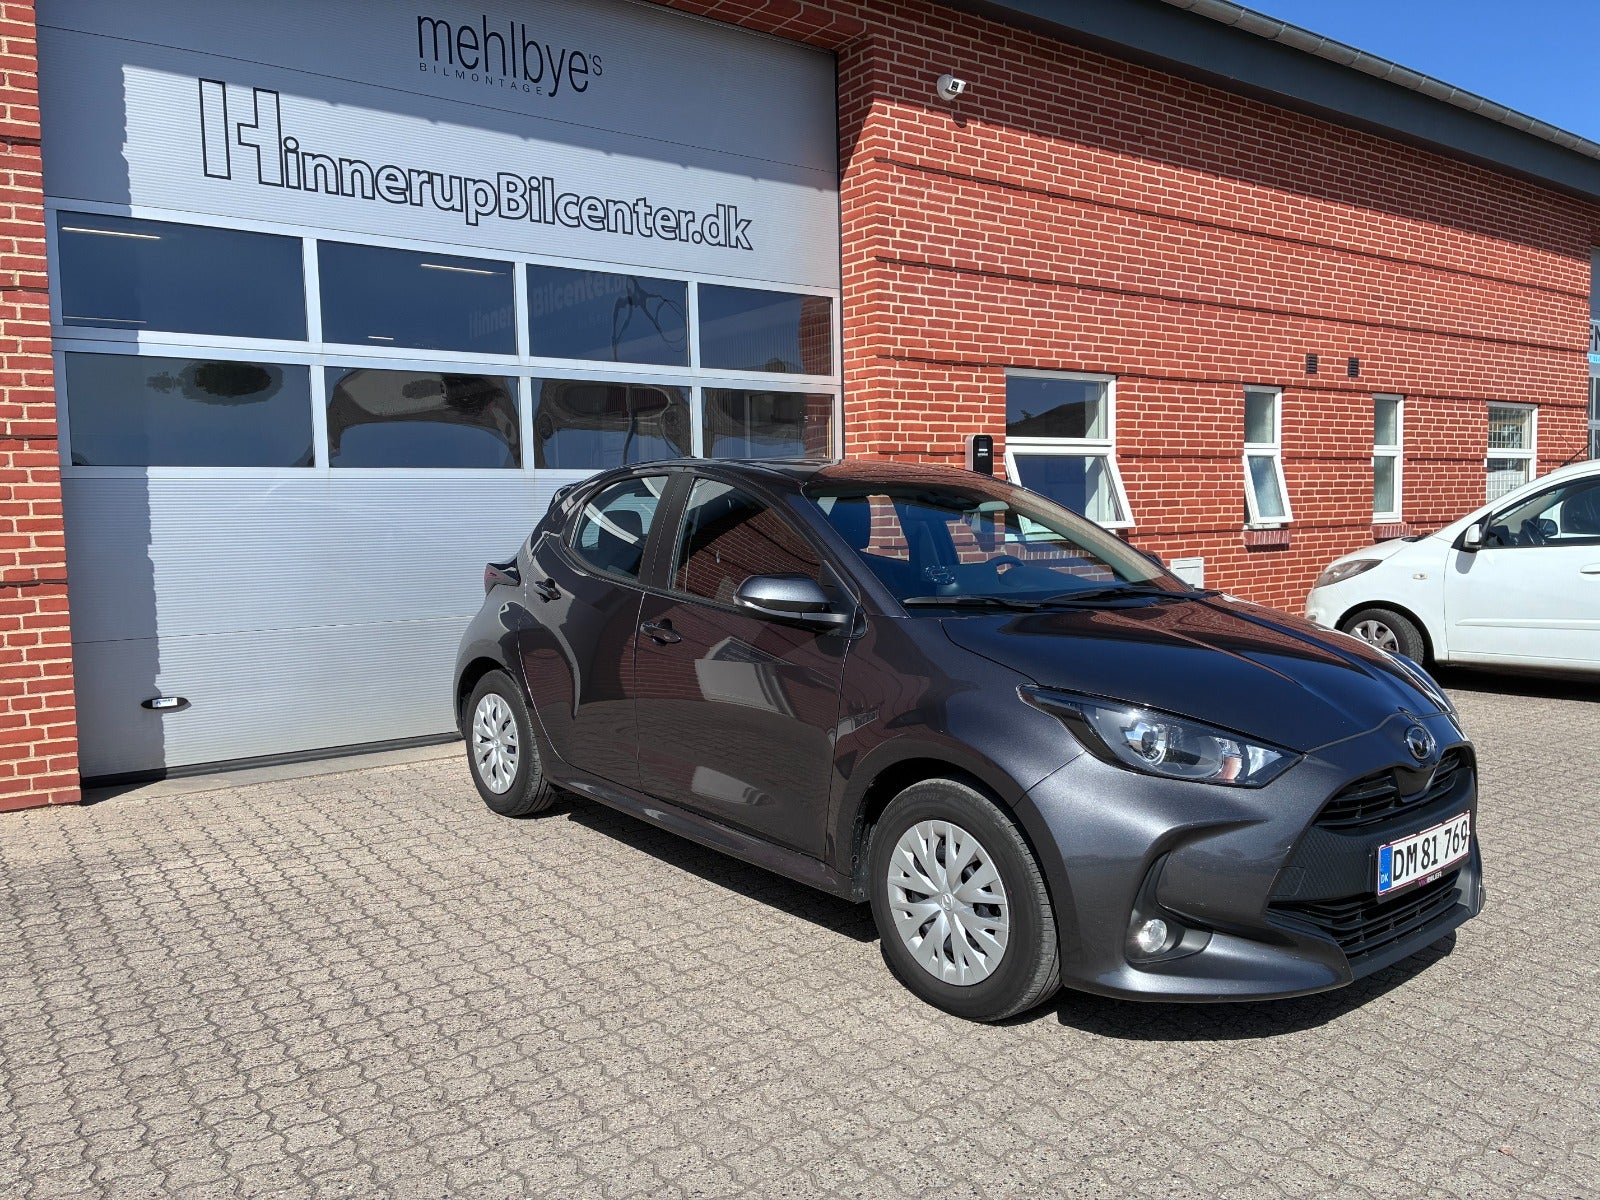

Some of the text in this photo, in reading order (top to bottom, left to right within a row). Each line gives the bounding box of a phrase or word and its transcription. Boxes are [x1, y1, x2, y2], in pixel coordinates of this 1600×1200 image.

[417, 14, 603, 98] mehlbye's
[419, 62, 543, 96] BILMONTAGE
[199, 77, 754, 251] HinnerupBilcenter.dk
[1381, 872, 1389, 885] DK
[1393, 819, 1468, 882] DM 81 769
